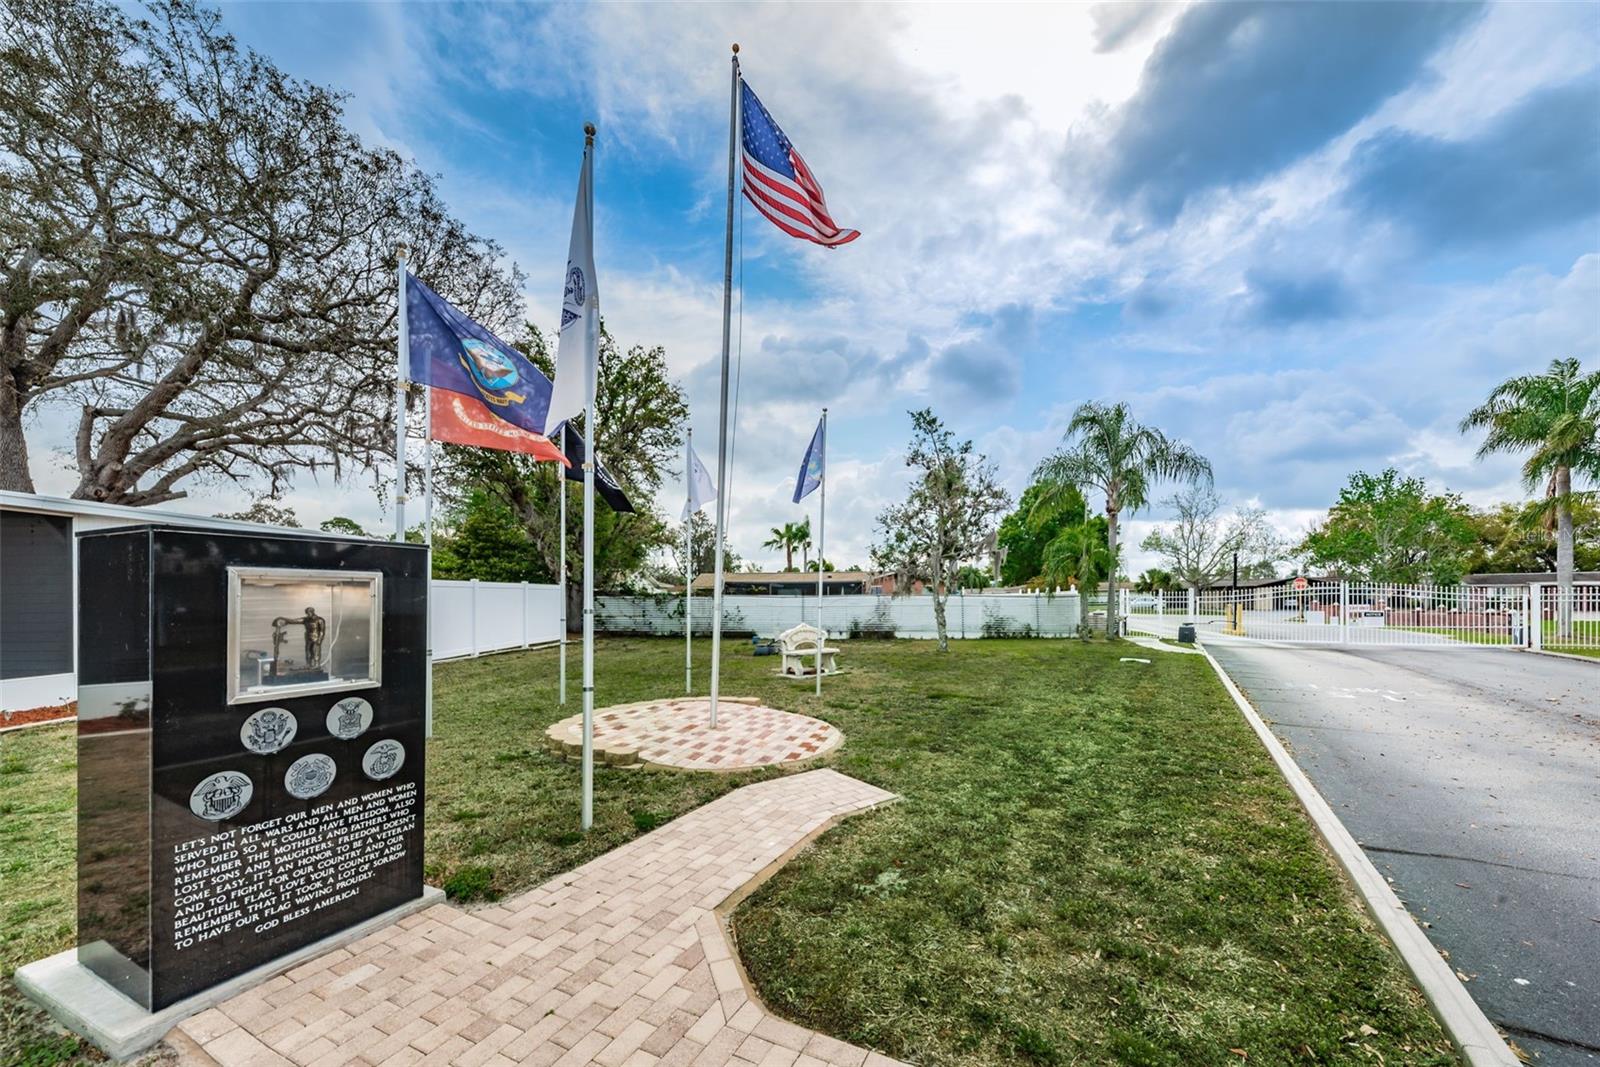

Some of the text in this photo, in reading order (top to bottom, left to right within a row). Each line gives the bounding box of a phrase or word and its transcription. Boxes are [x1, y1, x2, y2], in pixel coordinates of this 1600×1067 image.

[174, 783, 415, 853] LET'S NOT FORGET OUR MEN AND WOMEN WHO
[174, 790, 416, 864] SERVED IN ALL WARS AND ALL MEN AND WOMEN
[174, 799, 415, 875] WHO DIED SO WE COULD HAVE FREEDOM. ALSO
[174, 808, 409, 886] REMEMBER THE MOTHERS AND FATHERS WHO
[174, 814, 416, 897] LOST SONS AND DAUGHTERS. FREEDOM DOESN'T
[174, 823, 415, 907] COME EASY. IT'S AN HONOR TO BE A VETERAN
[174, 835, 404, 918] AND TO FIGHT FOR OUR COUNTRY AND OUR
[174, 843, 402, 929] BEAUTIFUL FLAG. LOVE YOUR COUNTRY AND
[174, 850, 406, 940] REMEMBER THAT IT TOOK A LOT OF SORROW
[174, 870, 376, 951] TO HAVE OUR FLAG WAVING PROUDLY.
[254, 887, 359, 934] GOD BLESS AMERICA!
